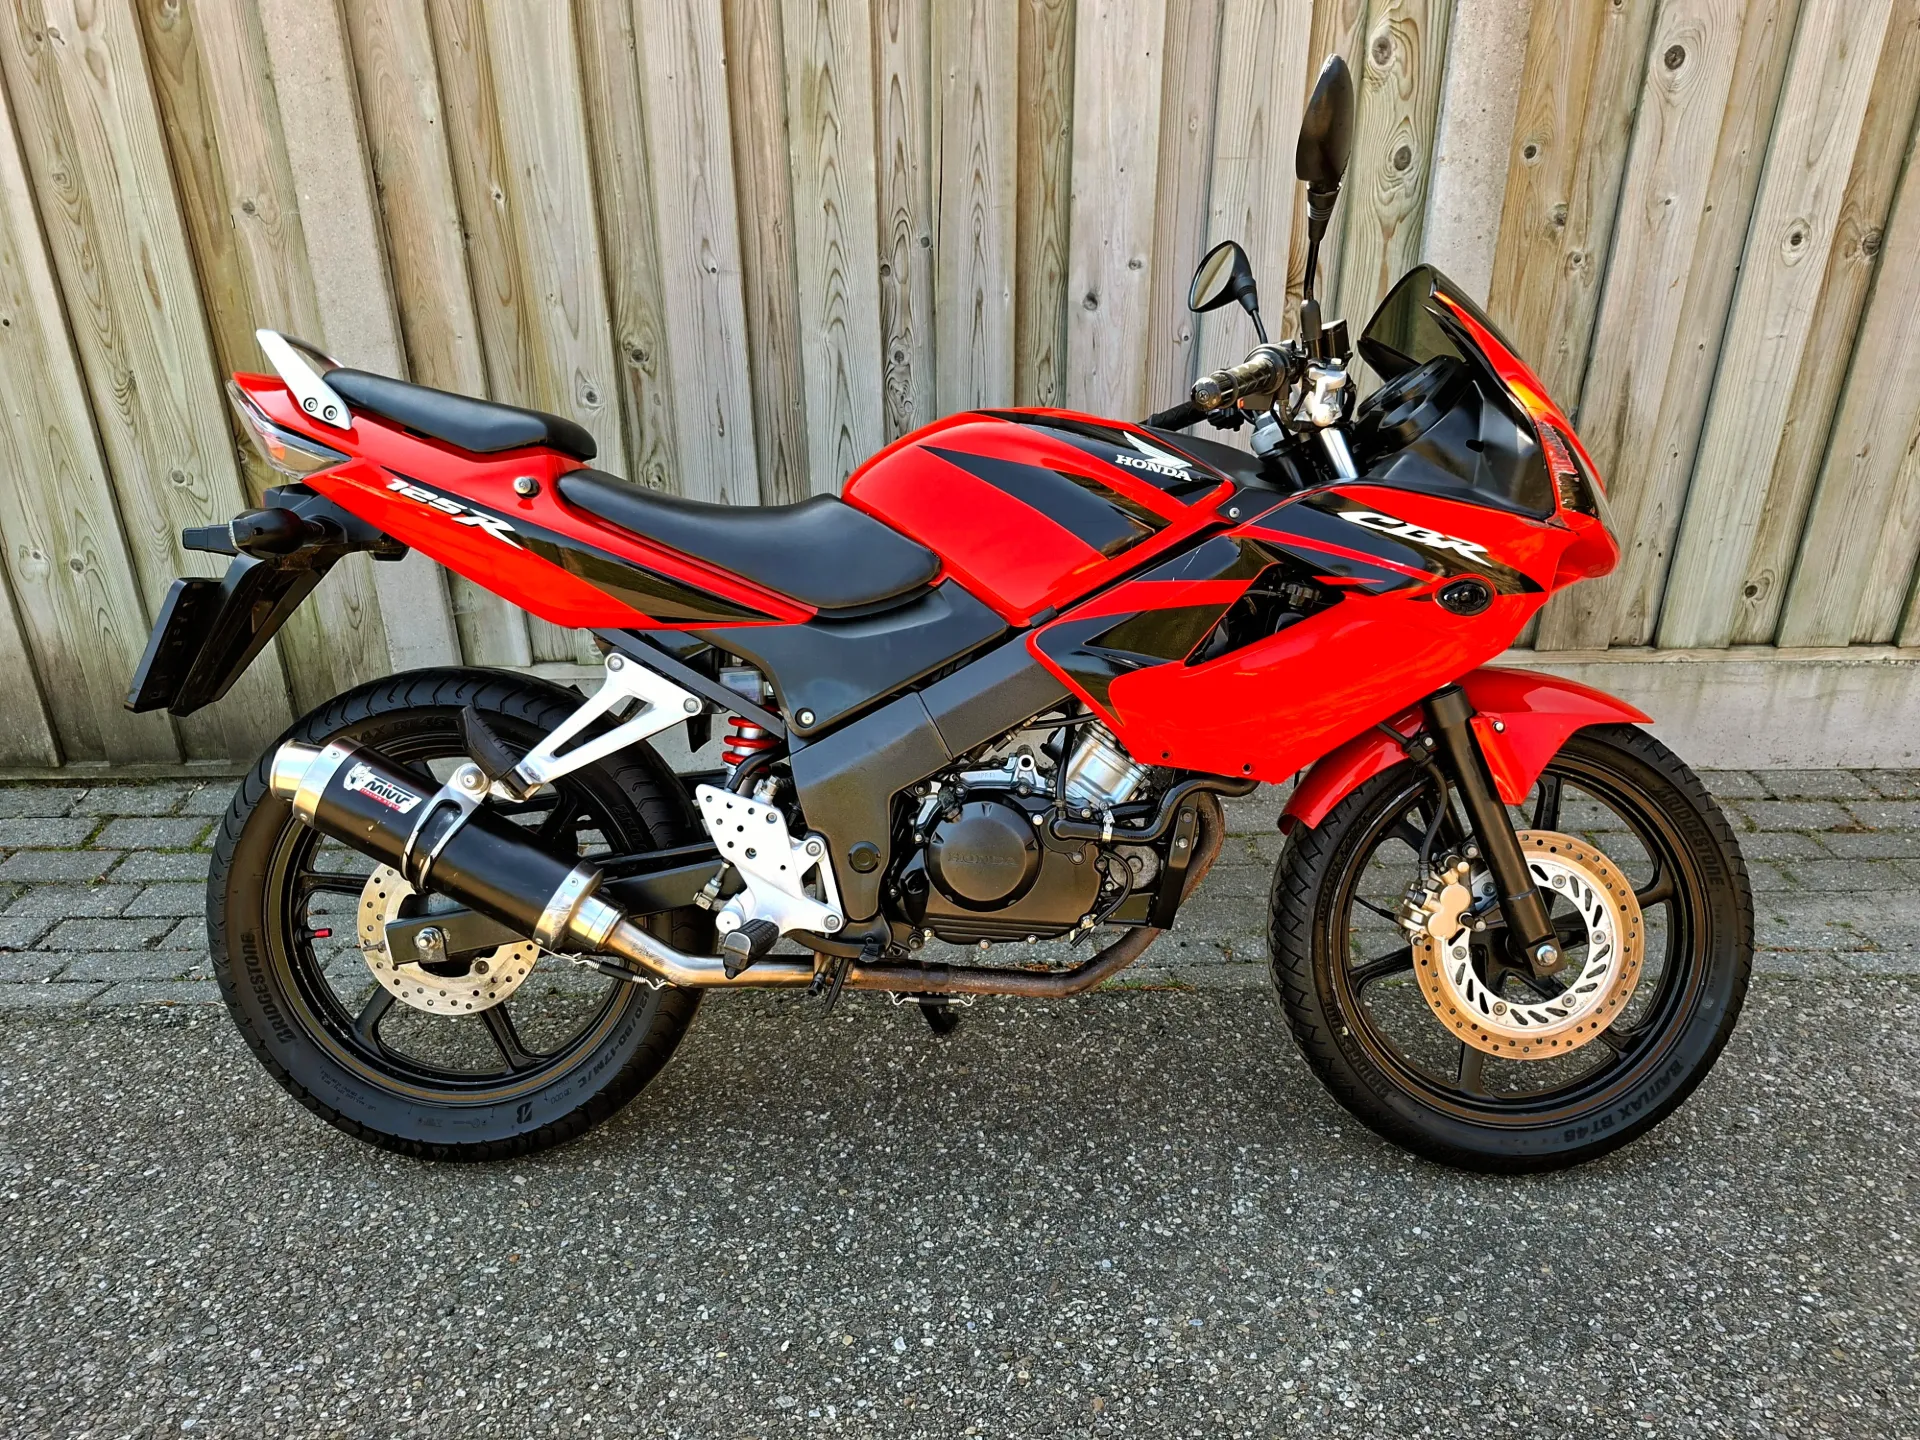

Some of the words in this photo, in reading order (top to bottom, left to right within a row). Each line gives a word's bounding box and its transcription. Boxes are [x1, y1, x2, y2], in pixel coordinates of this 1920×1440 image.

[1115, 454, 1192, 482] HONDA
[1337, 511, 1493, 568] CBR
[948, 852, 1019, 868] HONDA
[1652, 783, 1725, 886] BRIDGESTONE
[241, 932, 298, 1044] BRIDGESTONE
